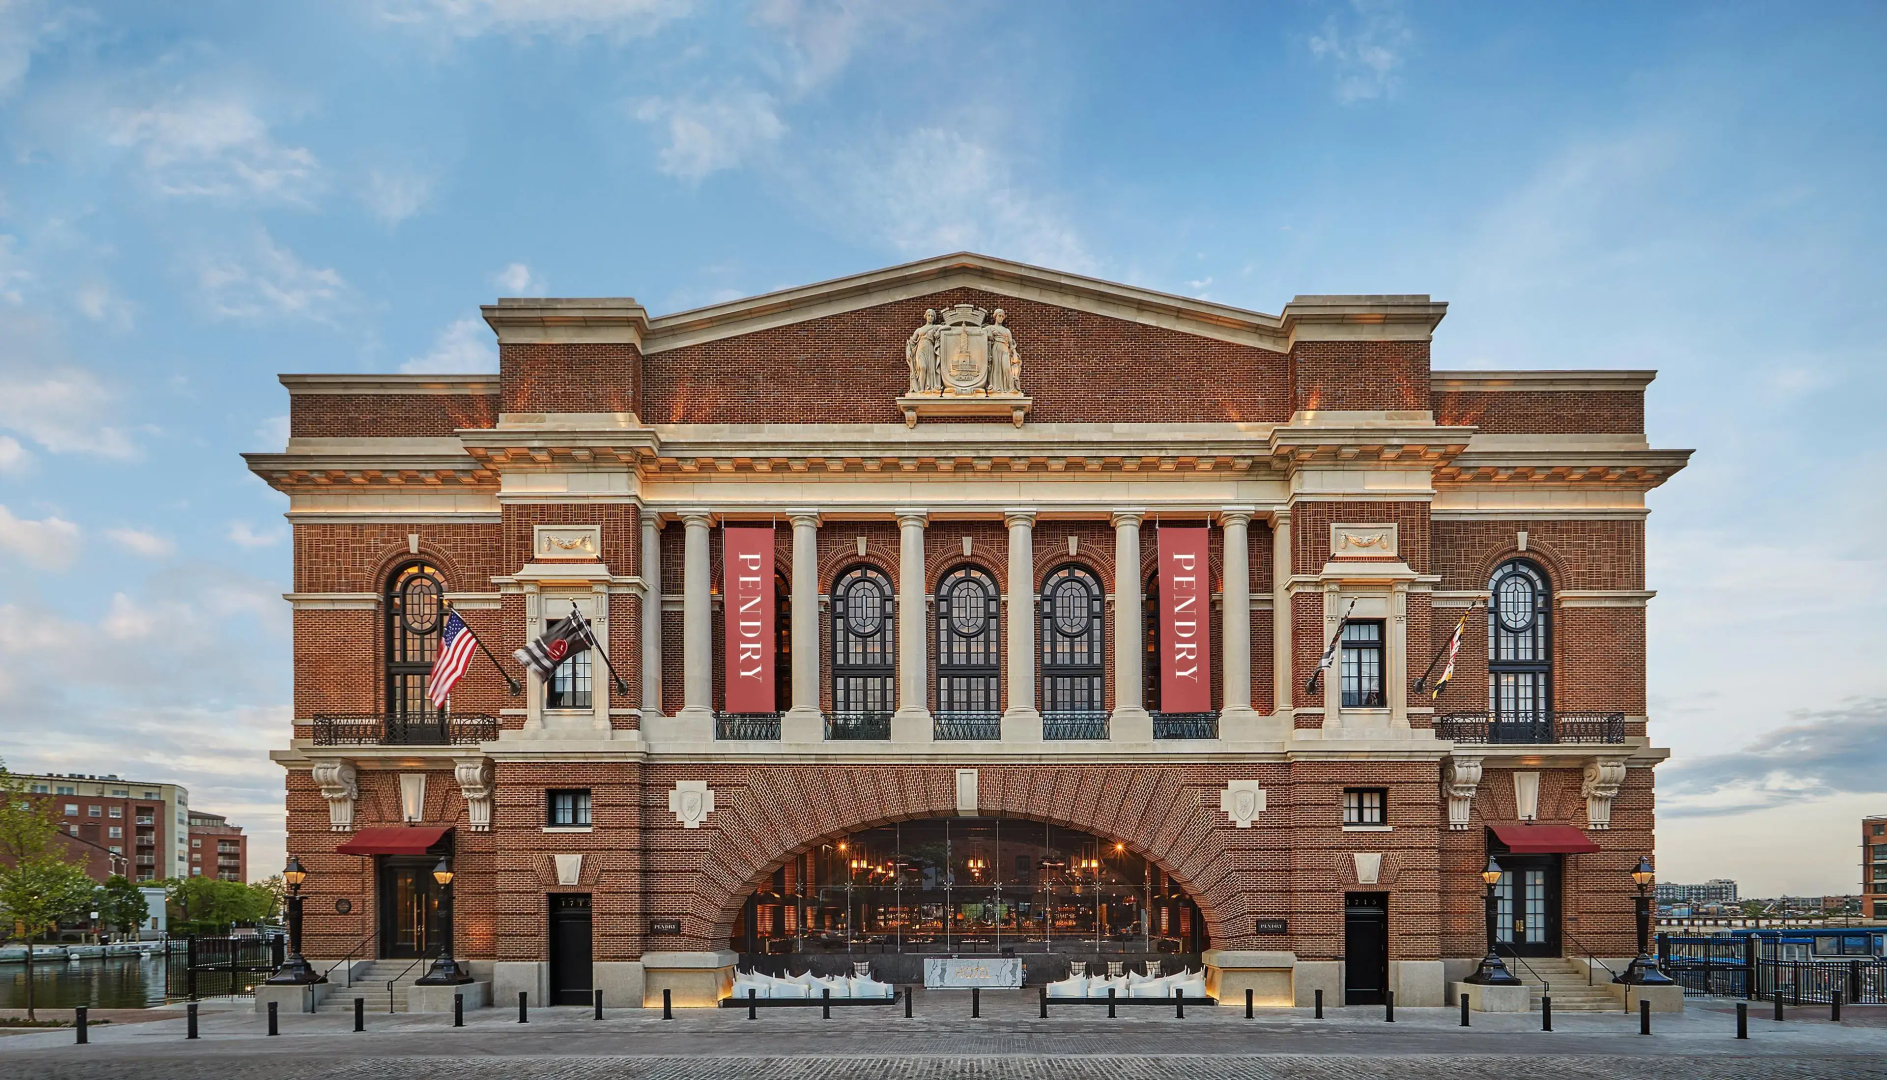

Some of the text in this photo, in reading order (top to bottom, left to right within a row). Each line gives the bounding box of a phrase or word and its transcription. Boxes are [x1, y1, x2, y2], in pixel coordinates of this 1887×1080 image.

[738, 552, 762, 683] PENDRY
[1173, 552, 1198, 683] PENDRY
[955, 966, 991, 979] HOTEL
